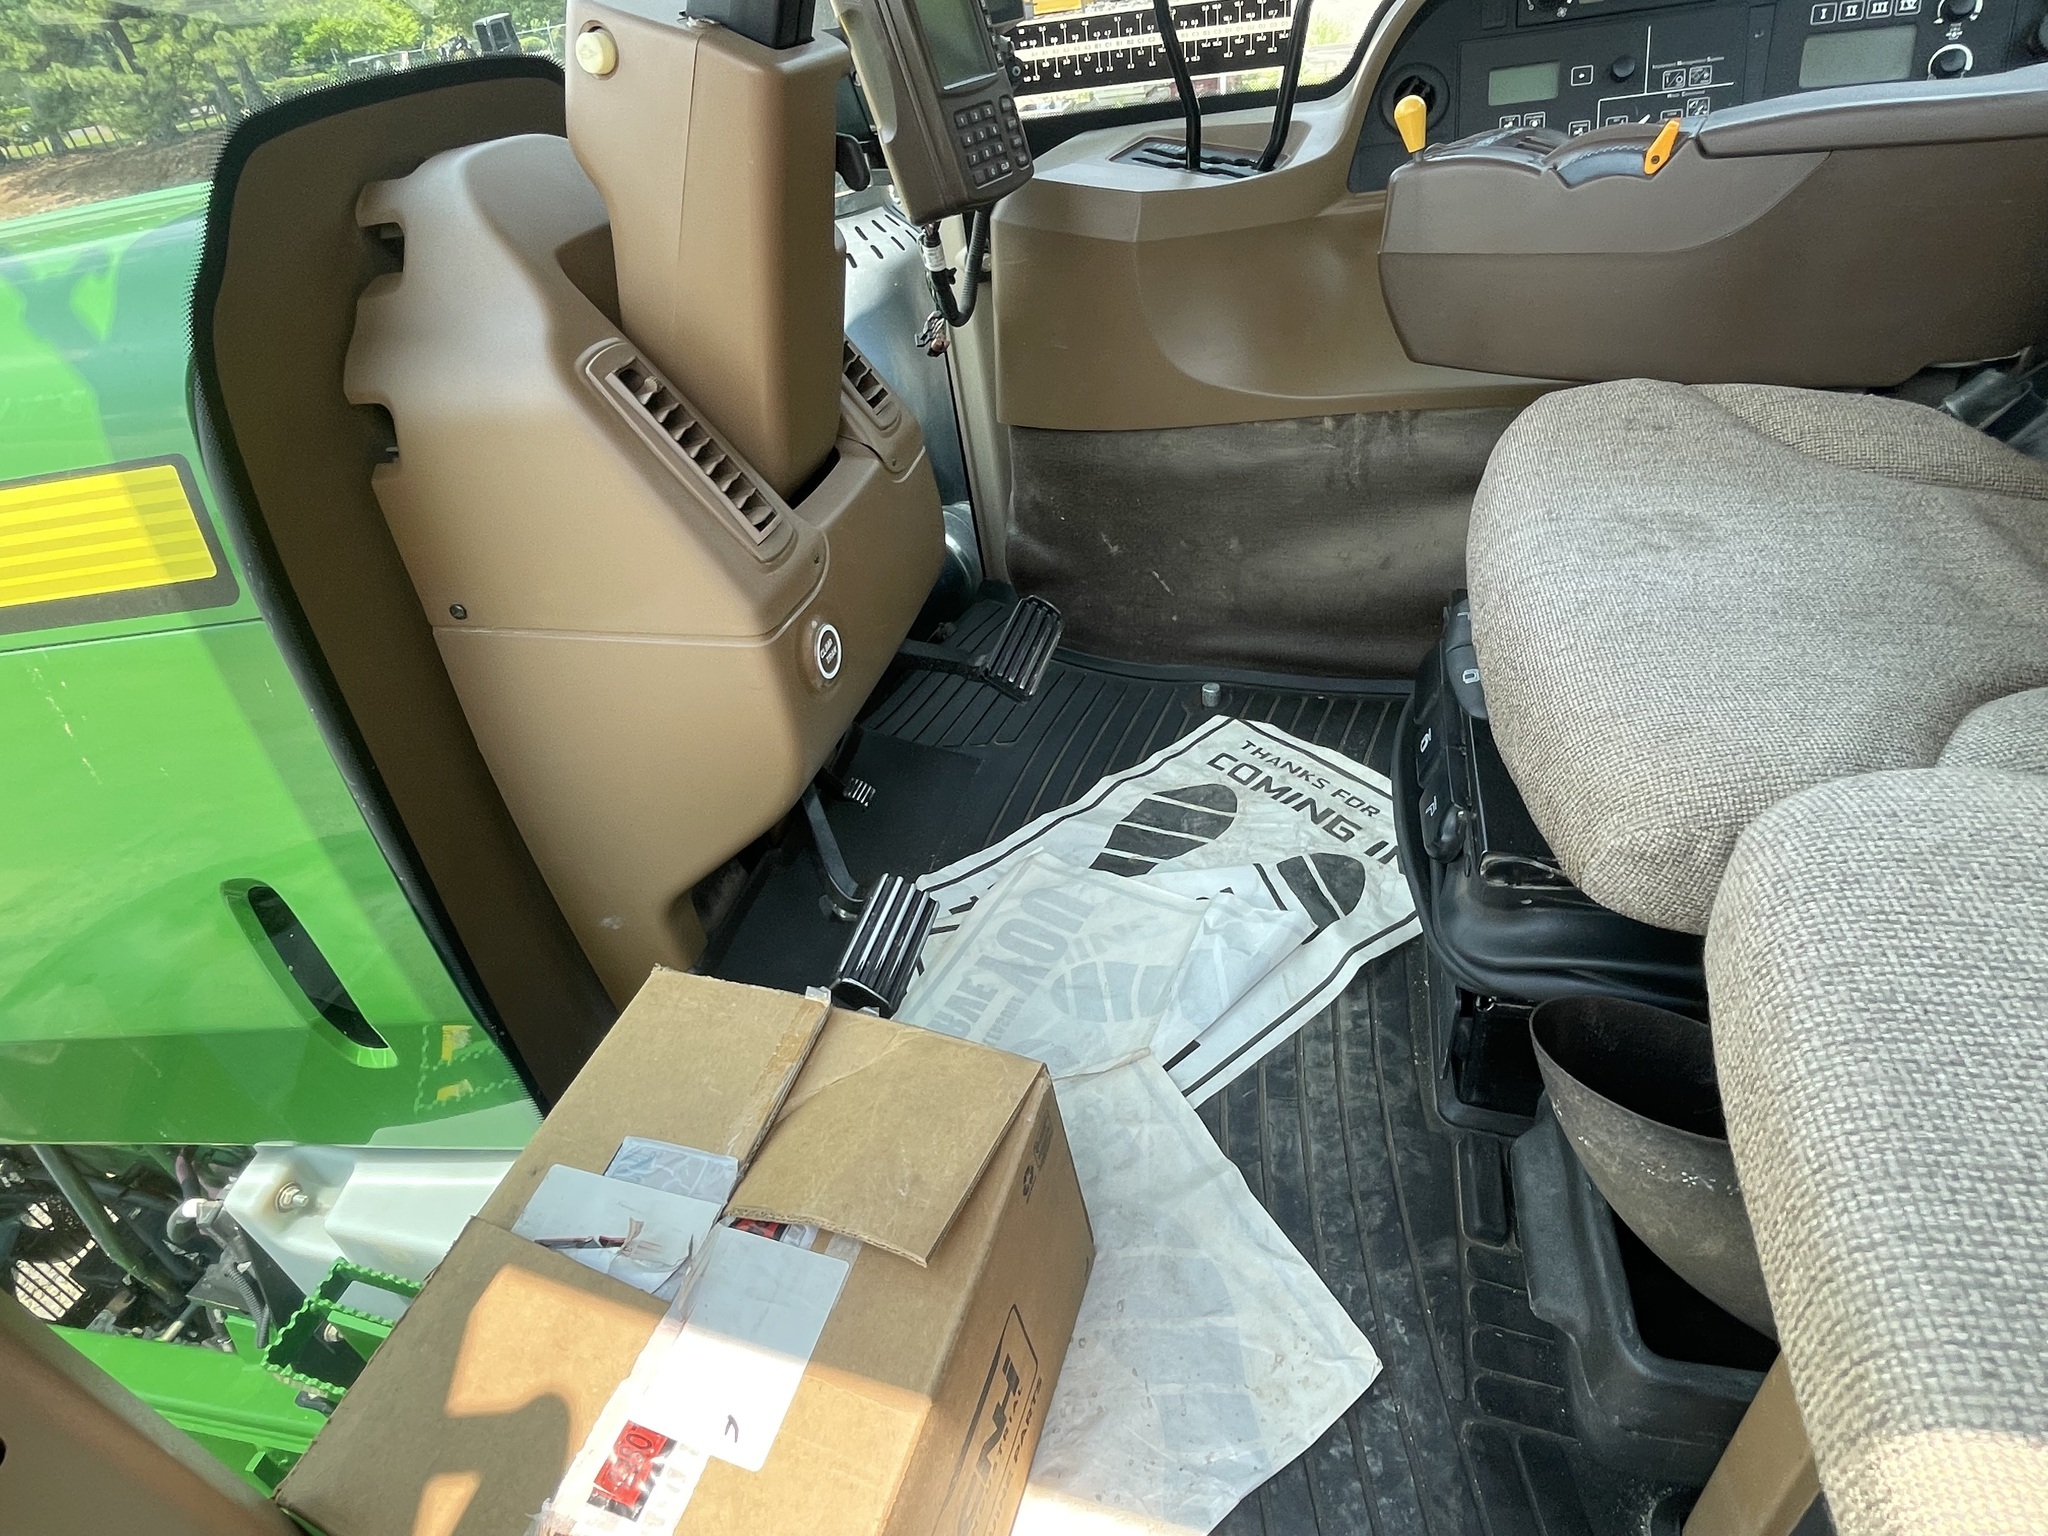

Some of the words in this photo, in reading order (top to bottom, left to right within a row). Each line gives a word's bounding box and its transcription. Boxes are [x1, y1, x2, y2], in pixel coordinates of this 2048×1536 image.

[1845, 5, 1858, 17] II
[1870, 2, 1889, 14] III
[1899, 0, 1917, 11] IV
[1820, 8, 1828, 20] I
[1241, 740, 1330, 790] THANKS
[1331, 788, 1381, 817] FOR
[1206, 752, 1363, 843] COMING
[1014, 1377, 1042, 1463] PARTS
